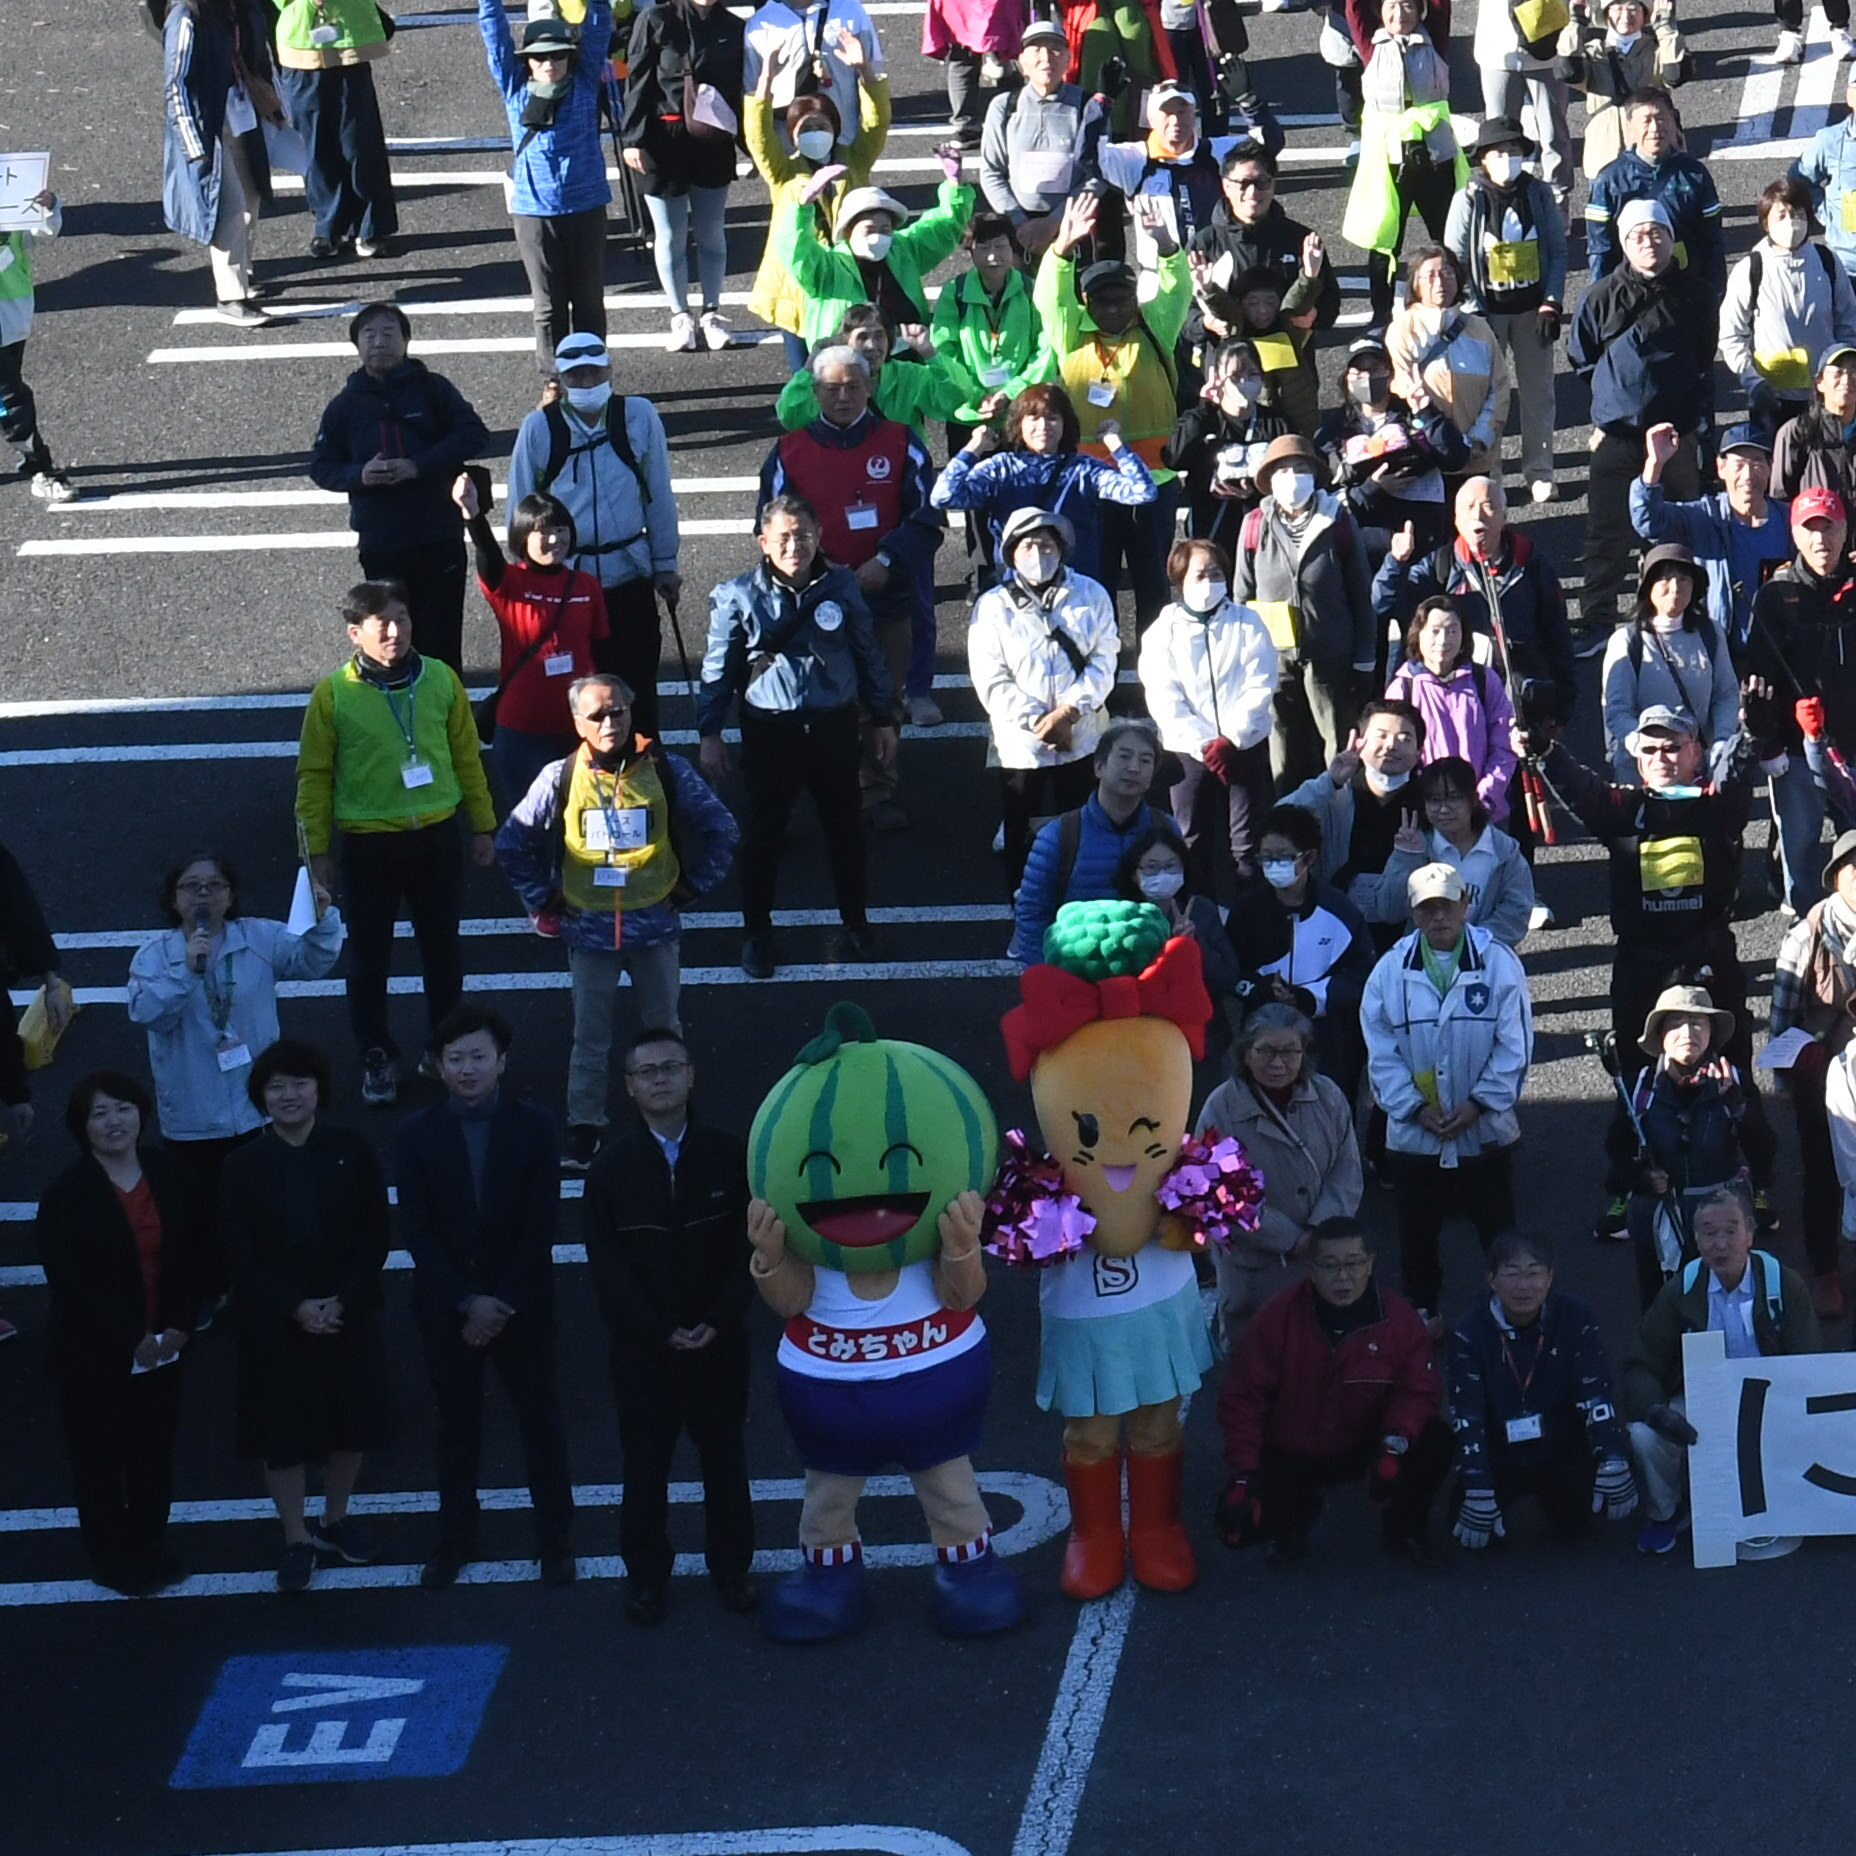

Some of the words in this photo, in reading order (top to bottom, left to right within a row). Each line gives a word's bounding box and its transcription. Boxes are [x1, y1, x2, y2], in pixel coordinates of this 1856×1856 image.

[0, 167, 17, 186] ト
[1642, 894, 1704, 913] hummel
[807, 1320, 949, 1362] とみちゃん
[241, 1671, 427, 1769] EV
